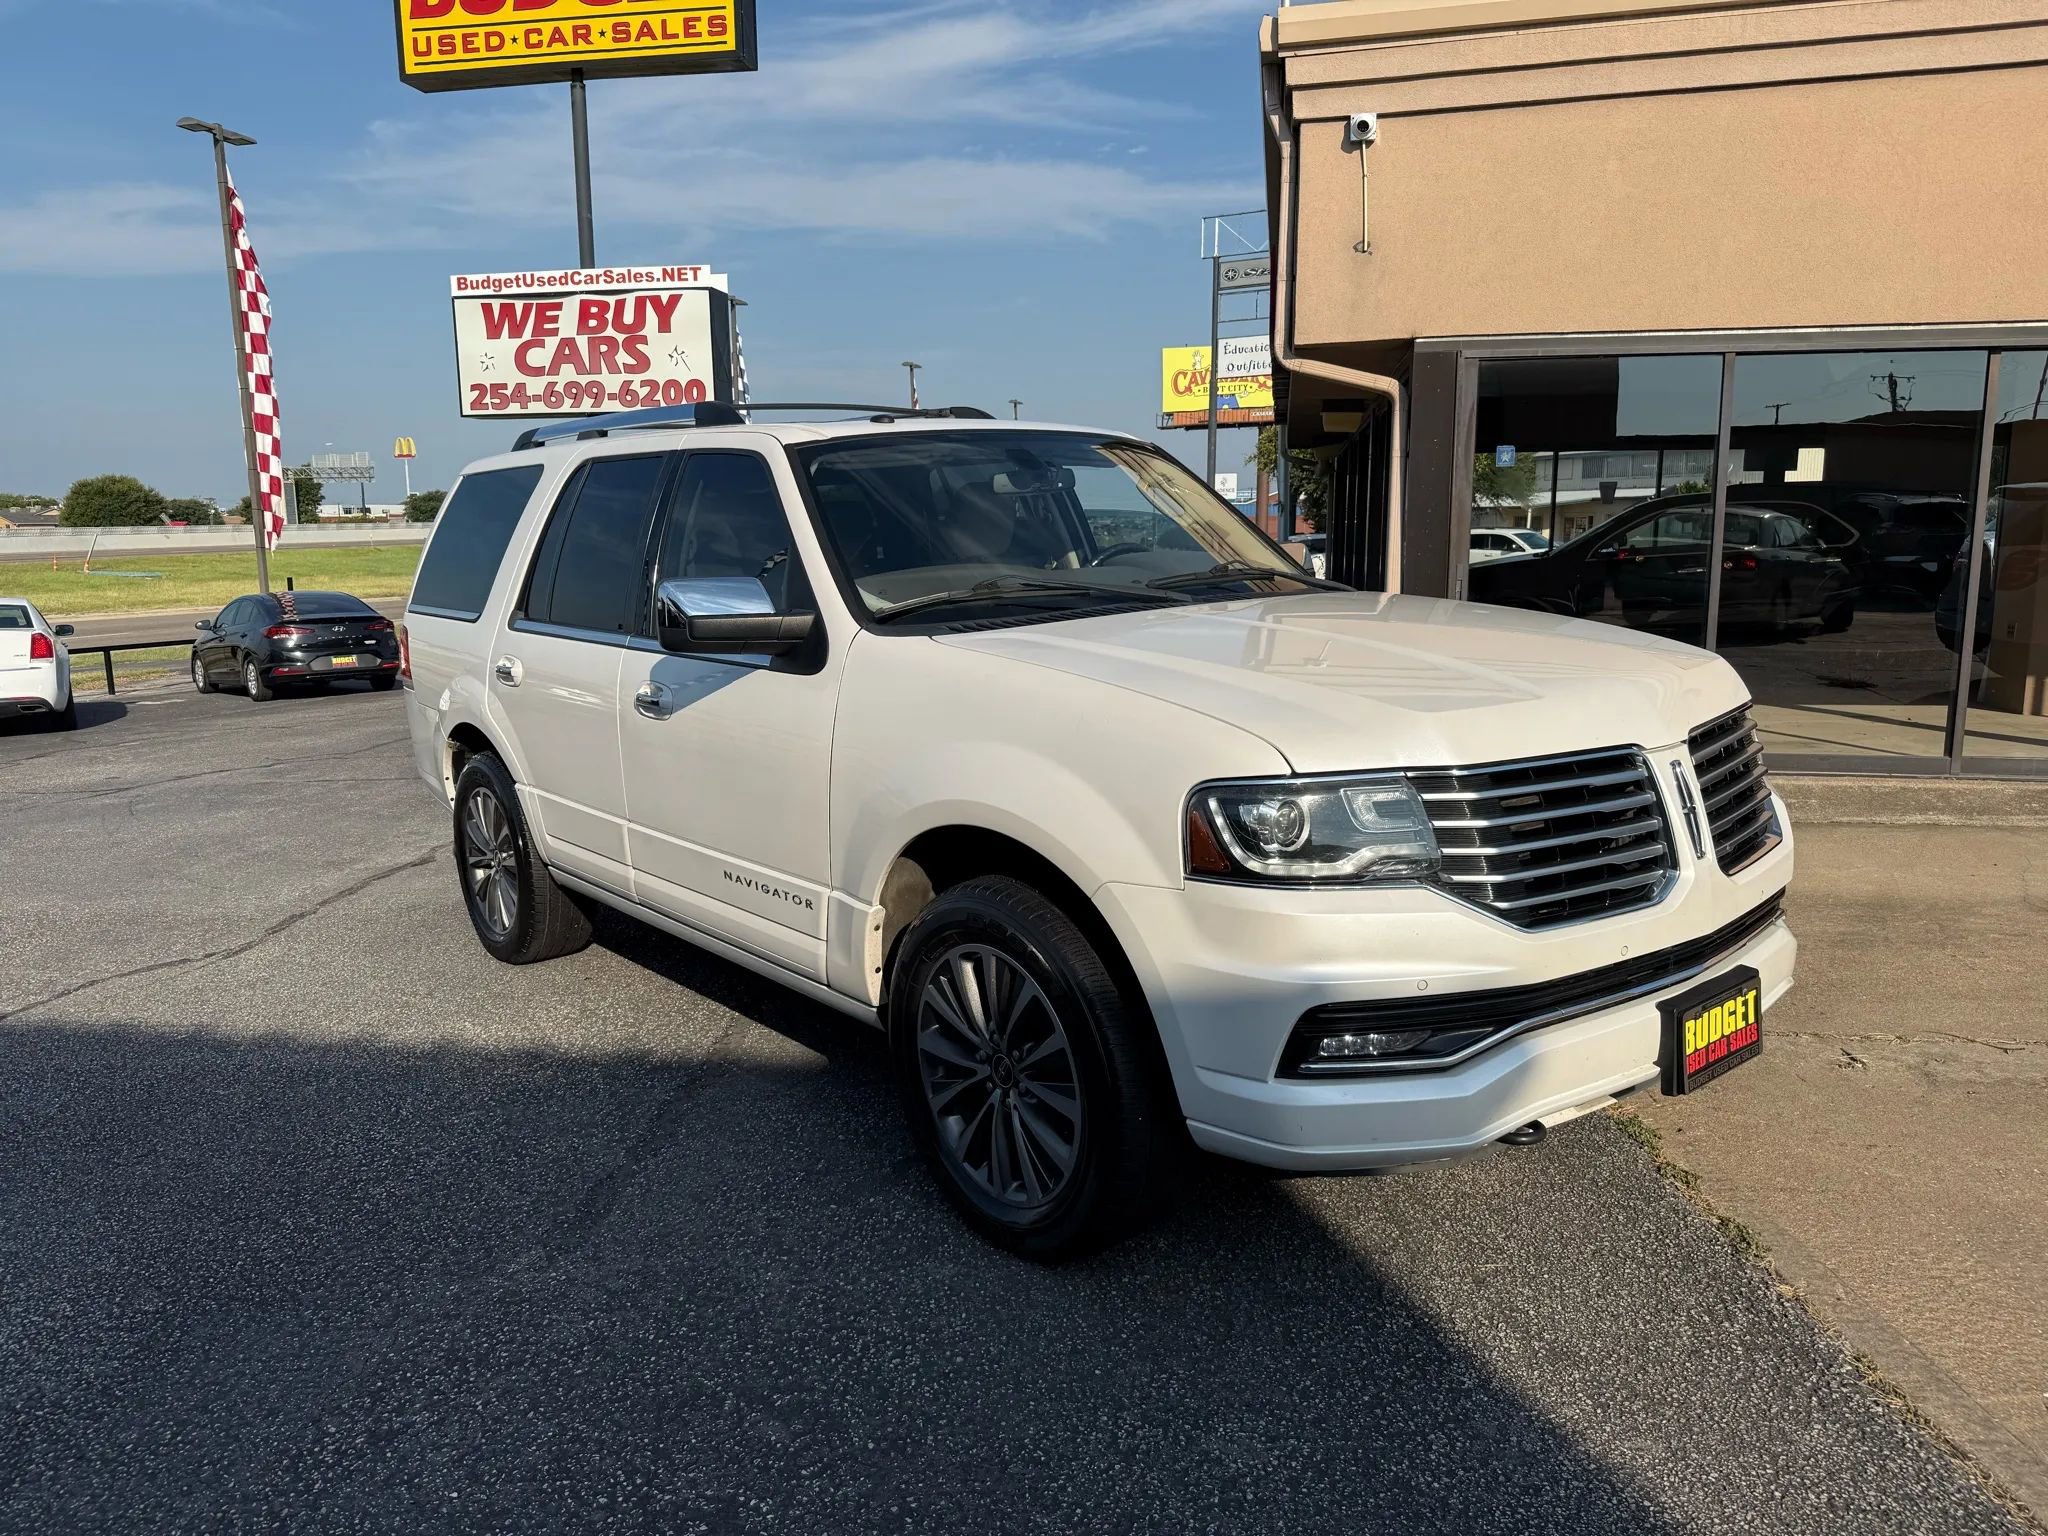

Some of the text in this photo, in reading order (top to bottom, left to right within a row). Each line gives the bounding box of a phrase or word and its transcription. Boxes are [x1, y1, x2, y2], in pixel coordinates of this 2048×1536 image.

[412, 15, 728, 57] USED CAR SALES
[456, 266, 702, 292] BudgetUsedCarSales.NET
[480, 294, 683, 340] WE BUY
[513, 335, 652, 377] CARS
[1224, 342, 1270, 354] Educatio
[469, 379, 707, 411] 254-699-6200
[1202, 384, 1248, 393] BT CITY
[723, 869, 814, 910] NAVIGATOR
[1685, 989, 1757, 1055] BUDGET
[1708, 1037, 1728, 1062] CAR
[1729, 1022, 1758, 1052] SALES
